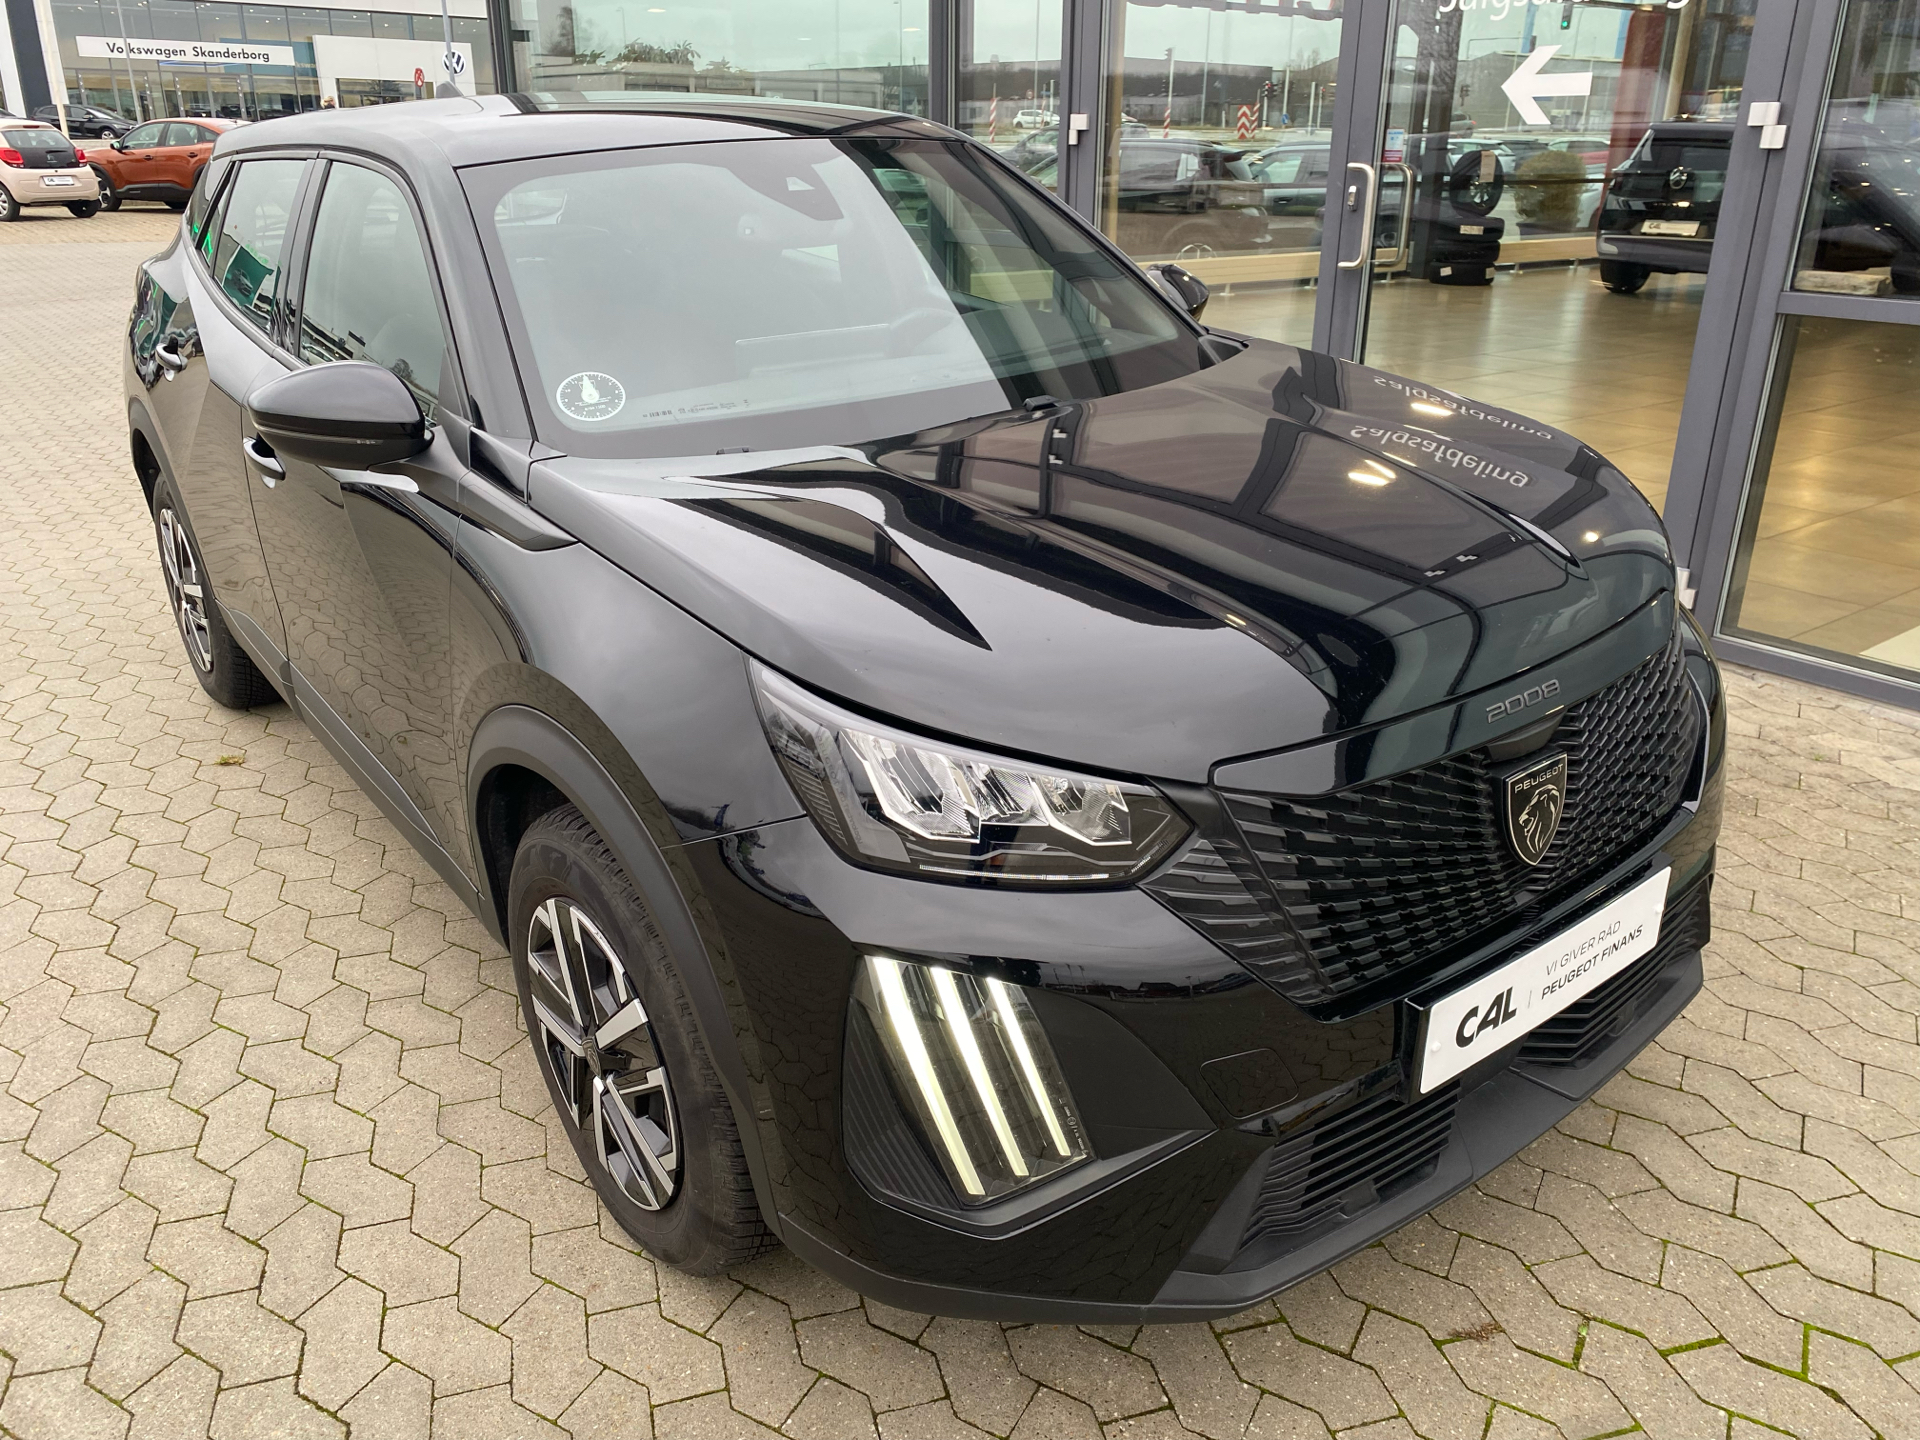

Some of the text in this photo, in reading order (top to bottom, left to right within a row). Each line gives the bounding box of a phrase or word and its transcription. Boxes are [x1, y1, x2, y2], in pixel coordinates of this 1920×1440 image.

[106, 42, 270, 63] Vokswagen Skanderborg
[1486, 679, 1560, 724] 2008
[1514, 763, 1564, 794] PEUGEOT
[1541, 924, 1644, 1000] PEUGEOT FINANS
[1546, 920, 1621, 976] VI GIVER RÅD
[1455, 986, 1518, 1048] CAL
